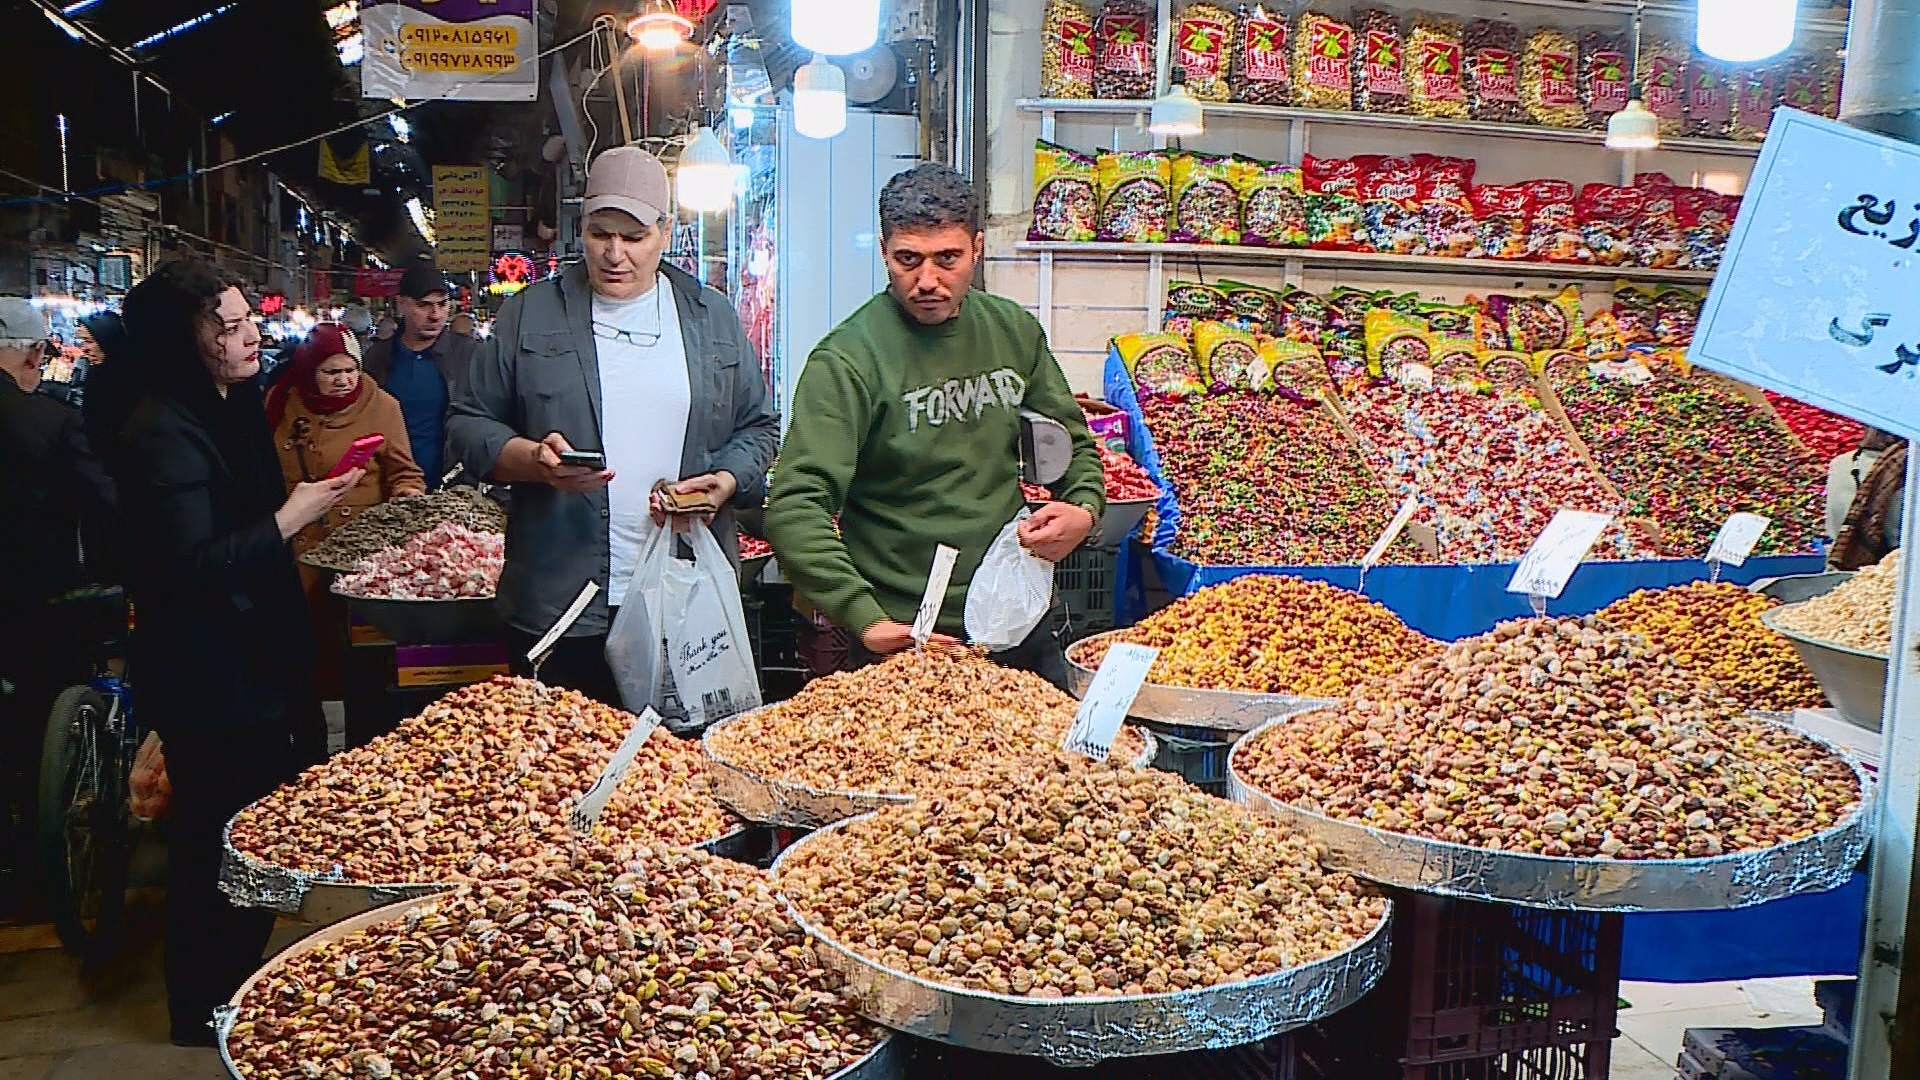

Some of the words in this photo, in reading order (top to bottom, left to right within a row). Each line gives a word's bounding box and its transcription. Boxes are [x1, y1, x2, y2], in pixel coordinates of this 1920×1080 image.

[406, 28, 511, 44] ۰۹۱۲۰۸۱۵۹۶۱
[406, 52, 516, 68] ۰۹۱۹۹۷۲۸۹۹۳
[902, 367, 1026, 434] FORWARD
[679, 637, 708, 667] Thank
